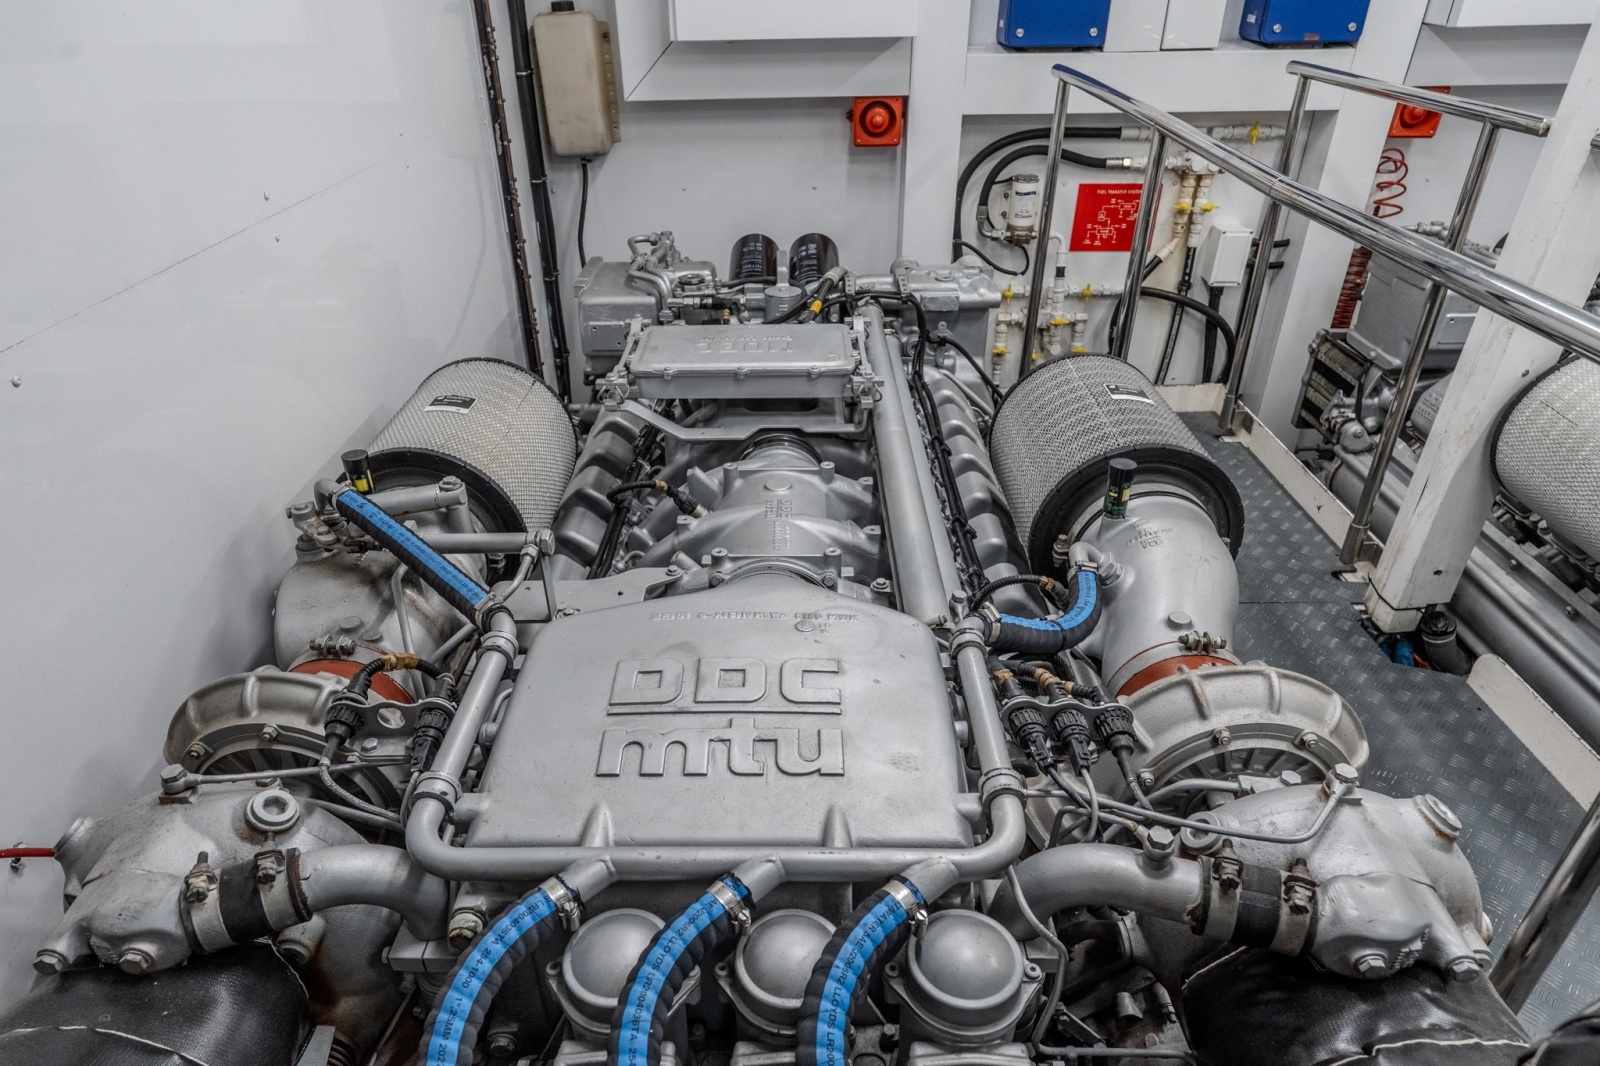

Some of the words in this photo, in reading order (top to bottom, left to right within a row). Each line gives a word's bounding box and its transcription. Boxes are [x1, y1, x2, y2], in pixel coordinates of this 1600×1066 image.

[608, 657, 842, 706] DDC
[596, 717, 845, 777] mtu
[651, 936, 679, 971] LLOYDS
[855, 932, 871, 950] SAE
[461, 947, 492, 989] 254-1000
[827, 986, 842, 1029] LLOYDS
